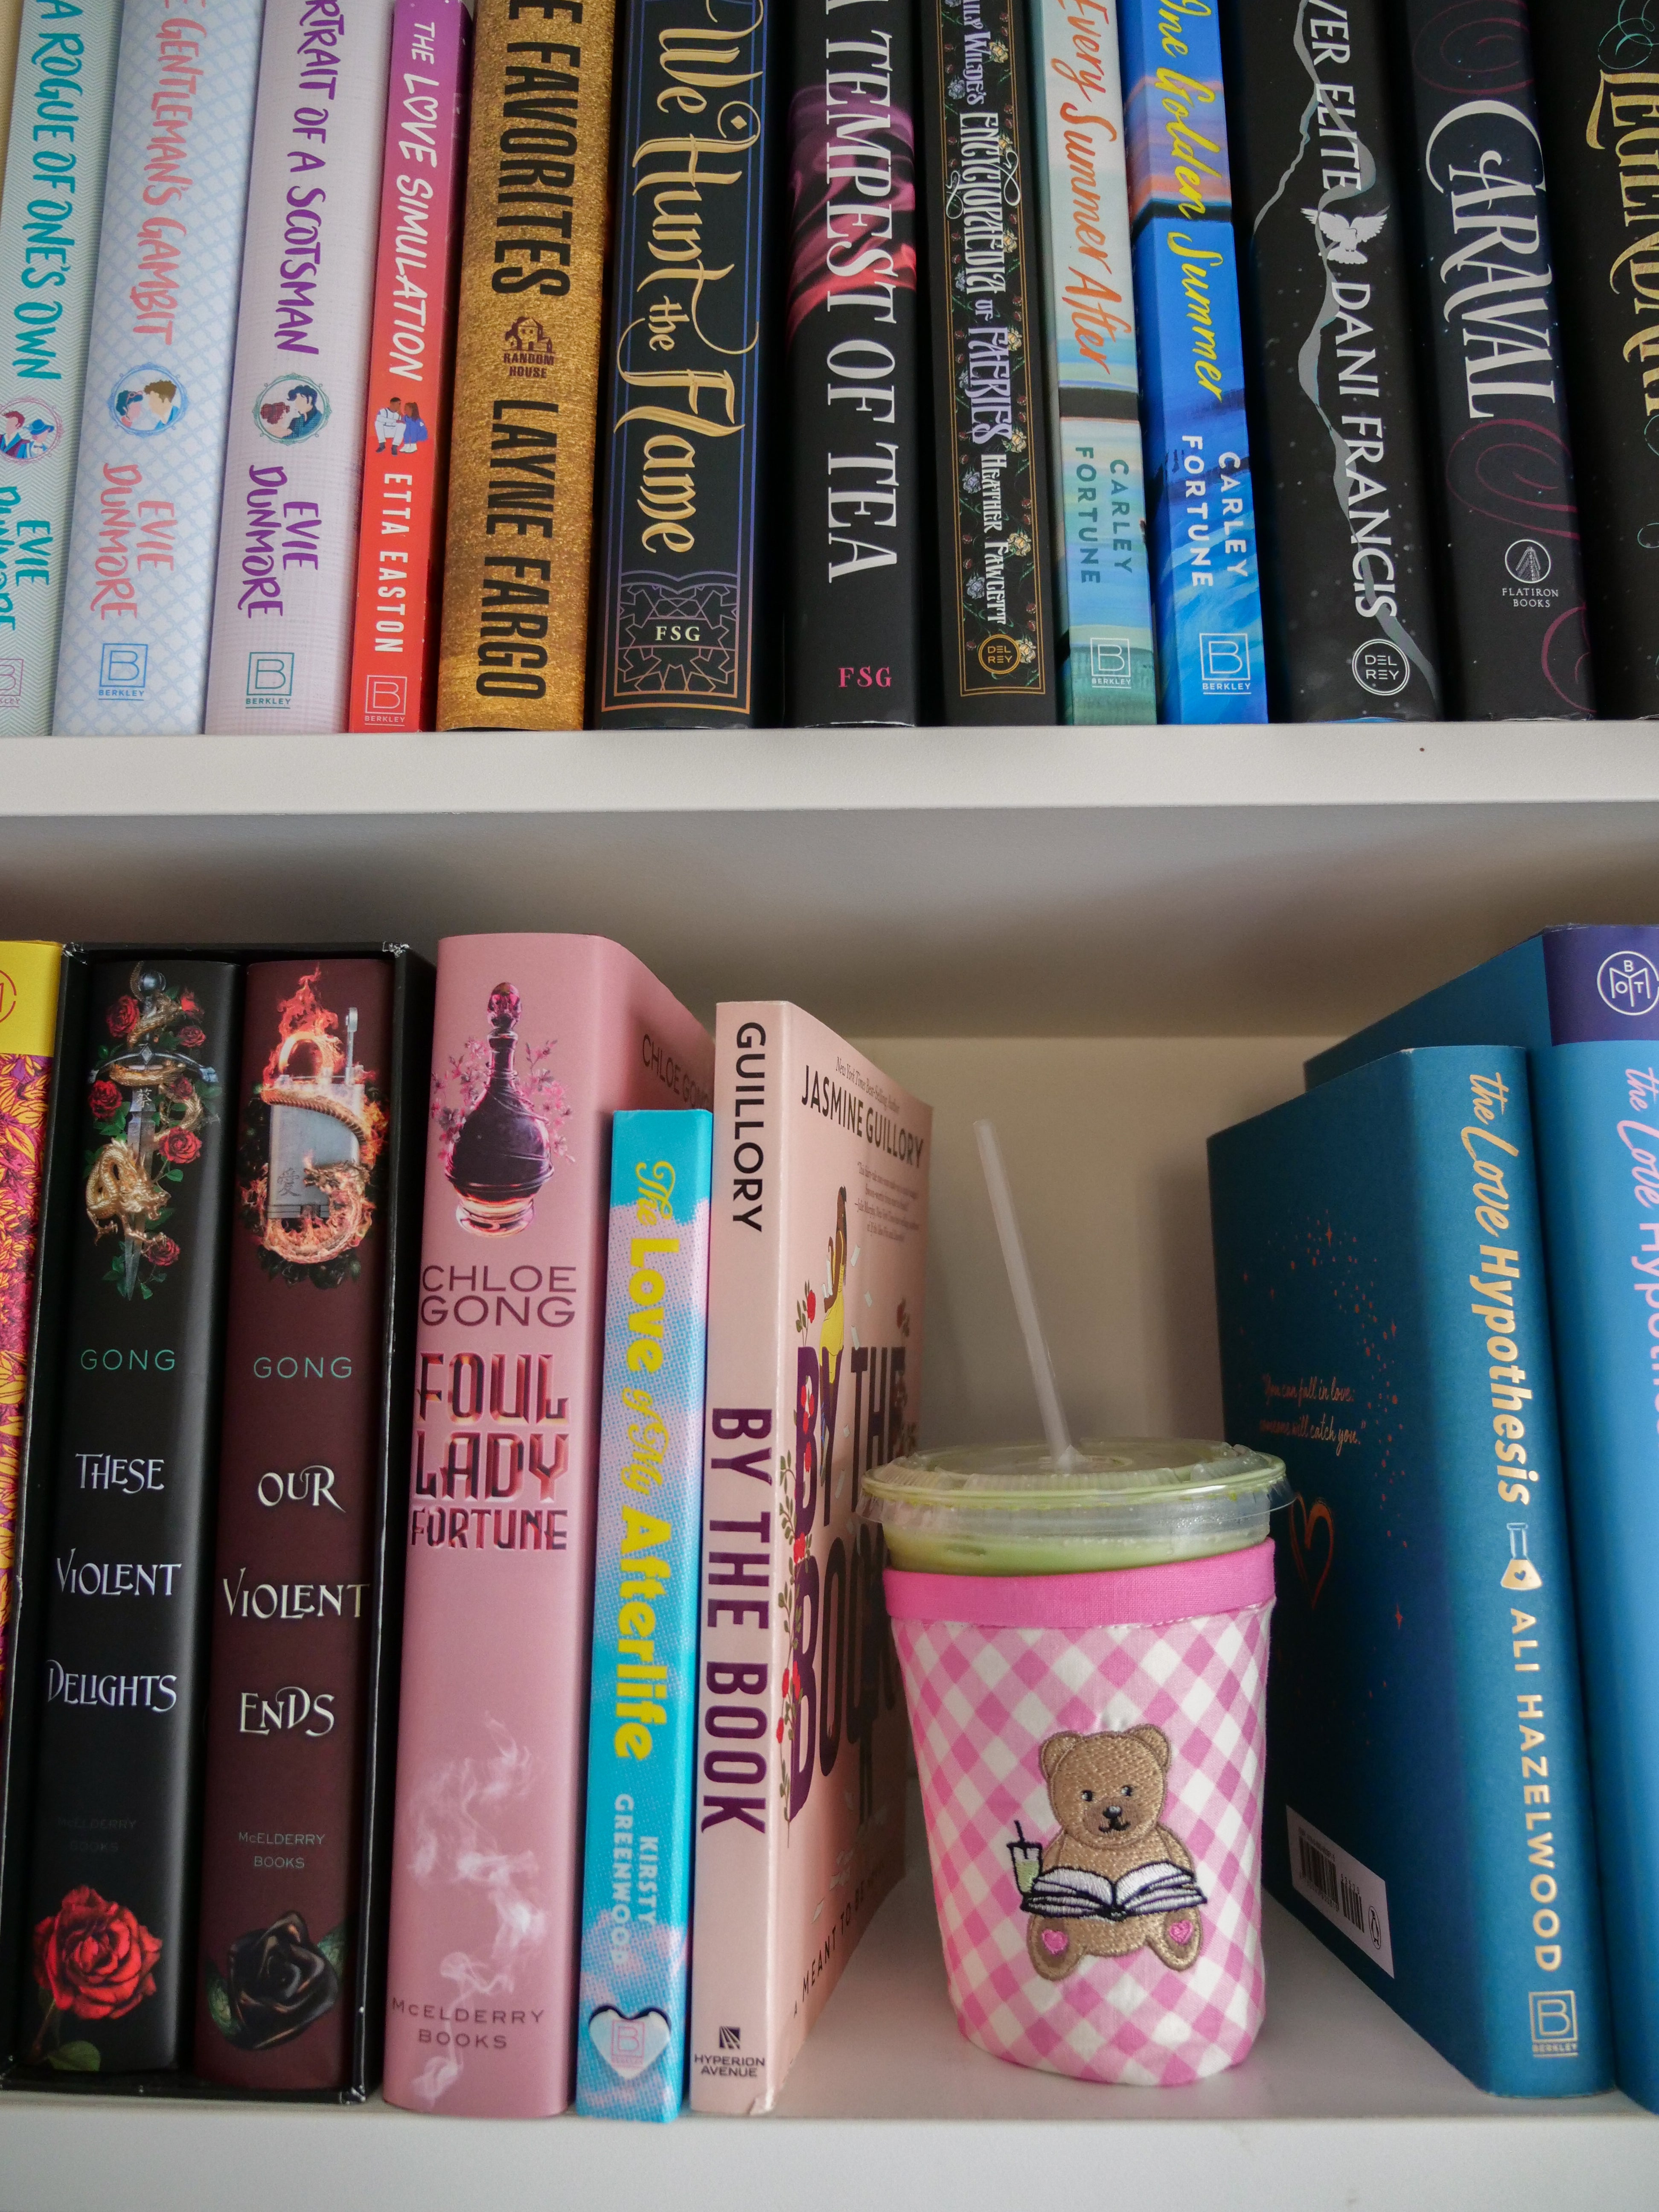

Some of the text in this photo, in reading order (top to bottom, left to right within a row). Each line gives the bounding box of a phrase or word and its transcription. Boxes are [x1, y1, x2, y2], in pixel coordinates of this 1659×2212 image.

[143, 18, 207, 206] GENTLEMAN'S
[292, 107, 329, 144] OF
[1155, 67, 1222, 221] Golden
[1315, 83, 1362, 191] ELITE
[13, 0, 84, 380] A ROGUE OF ONE'S OWN
[287, 151, 326, 173] A
[389, 22, 440, 381] THE LOVE SIMULATION
[491, 42, 581, 297] FAVORITES
[826, 30, 897, 324] TEMPEST
[1059, 102, 1118, 276] Summer
[130, 216, 187, 346] GAMBIT
[274, 185, 326, 355] SCOTSMAN
[613, 0, 763, 553] We Hunt the Flame
[1426, 99, 1555, 419] CARAVAL
[1061, 266, 1132, 375] After
[1167, 231, 1224, 404] Summer
[1331, 281, 1380, 397] DANI
[503, 353, 555, 365] RANDOM
[509, 367, 547, 378] HOUSE
[826, 339, 896, 424] OF
[967, 326, 1013, 445] FAERIES
[828, 442, 899, 584] TEA
[981, 454, 1008, 533] HEATHER
[1075, 446, 1101, 584] FORTUNE
[1109, 459, 1133, 574] CARLEY
[1182, 435, 1214, 588] FORTUNE
[1218, 452, 1249, 578] CARLEY
[1342, 416, 1398, 618] FRANCIS
[15, 520, 53, 586] EVIE
[90, 462, 143, 620] DUNMORE
[137, 500, 178, 572] EVIE
[237, 465, 288, 619] DUNMORE
[282, 501, 323, 571] EVIE
[375, 473, 413, 653] ETTA EASTON
[476, 399, 559, 700] LAYNE FARGO
[984, 541, 1010, 626] FAWCETT
[1502, 587, 1559, 598] FLATIRON
[1513, 599, 1551, 608] BOOKS
[655, 626, 701, 642] FSG
[987, 646, 1012, 655] DEL
[987, 656, 1013, 664] REY
[1365, 655, 1397, 667] DEL
[838, 667, 892, 688] FSG
[1202, 682, 1251, 690] BERKLEY
[1365, 669, 1400, 681] REY
[642, 1033, 681, 1095] CHLOE
[732, 1022, 767, 1234] GUILLORY
[801, 1065, 924, 1169] JASMINE GUILLORY
[420, 1295, 576, 1328] GONG
[421, 1264, 577, 1294] CHLOE
[81, 1349, 175, 1371] GONG
[253, 1356, 352, 1379] GONG
[416, 1351, 570, 1426] FOUL
[75, 1453, 165, 1494] THESE
[258, 1465, 346, 1513] OUR
[413, 1430, 570, 1503] LADY
[614, 1160, 681, 1761] The Love of My Afterlife
[410, 1507, 569, 1551] FORTUNE
[1461, 1072, 1562, 1971] the Love Hypothesis ALI HAZELWOOD
[56, 1548, 182, 1596] VIOLENT
[223, 1567, 370, 1619] VIOLENT
[701, 1407, 772, 1834] BY THE BOOK
[47, 1659, 178, 1713] DELIGHTS
[239, 1686, 335, 1738] ENDS
[238, 1831, 326, 1846] McELDERRY
[254, 1855, 306, 1870] BOOKS
[611, 1793, 635, 1965] GREENWOOD
[638, 1836, 659, 1928] KIRSTY
[802, 1925, 837, 2002] MEANT
[841, 1902, 851, 1935] TO
[391, 1997, 544, 2024] McELDERRY
[418, 2028, 508, 2049] BOOKS
[694, 2053, 765, 2066] HYPERION
[701, 2066, 758, 2078] AVENUE
